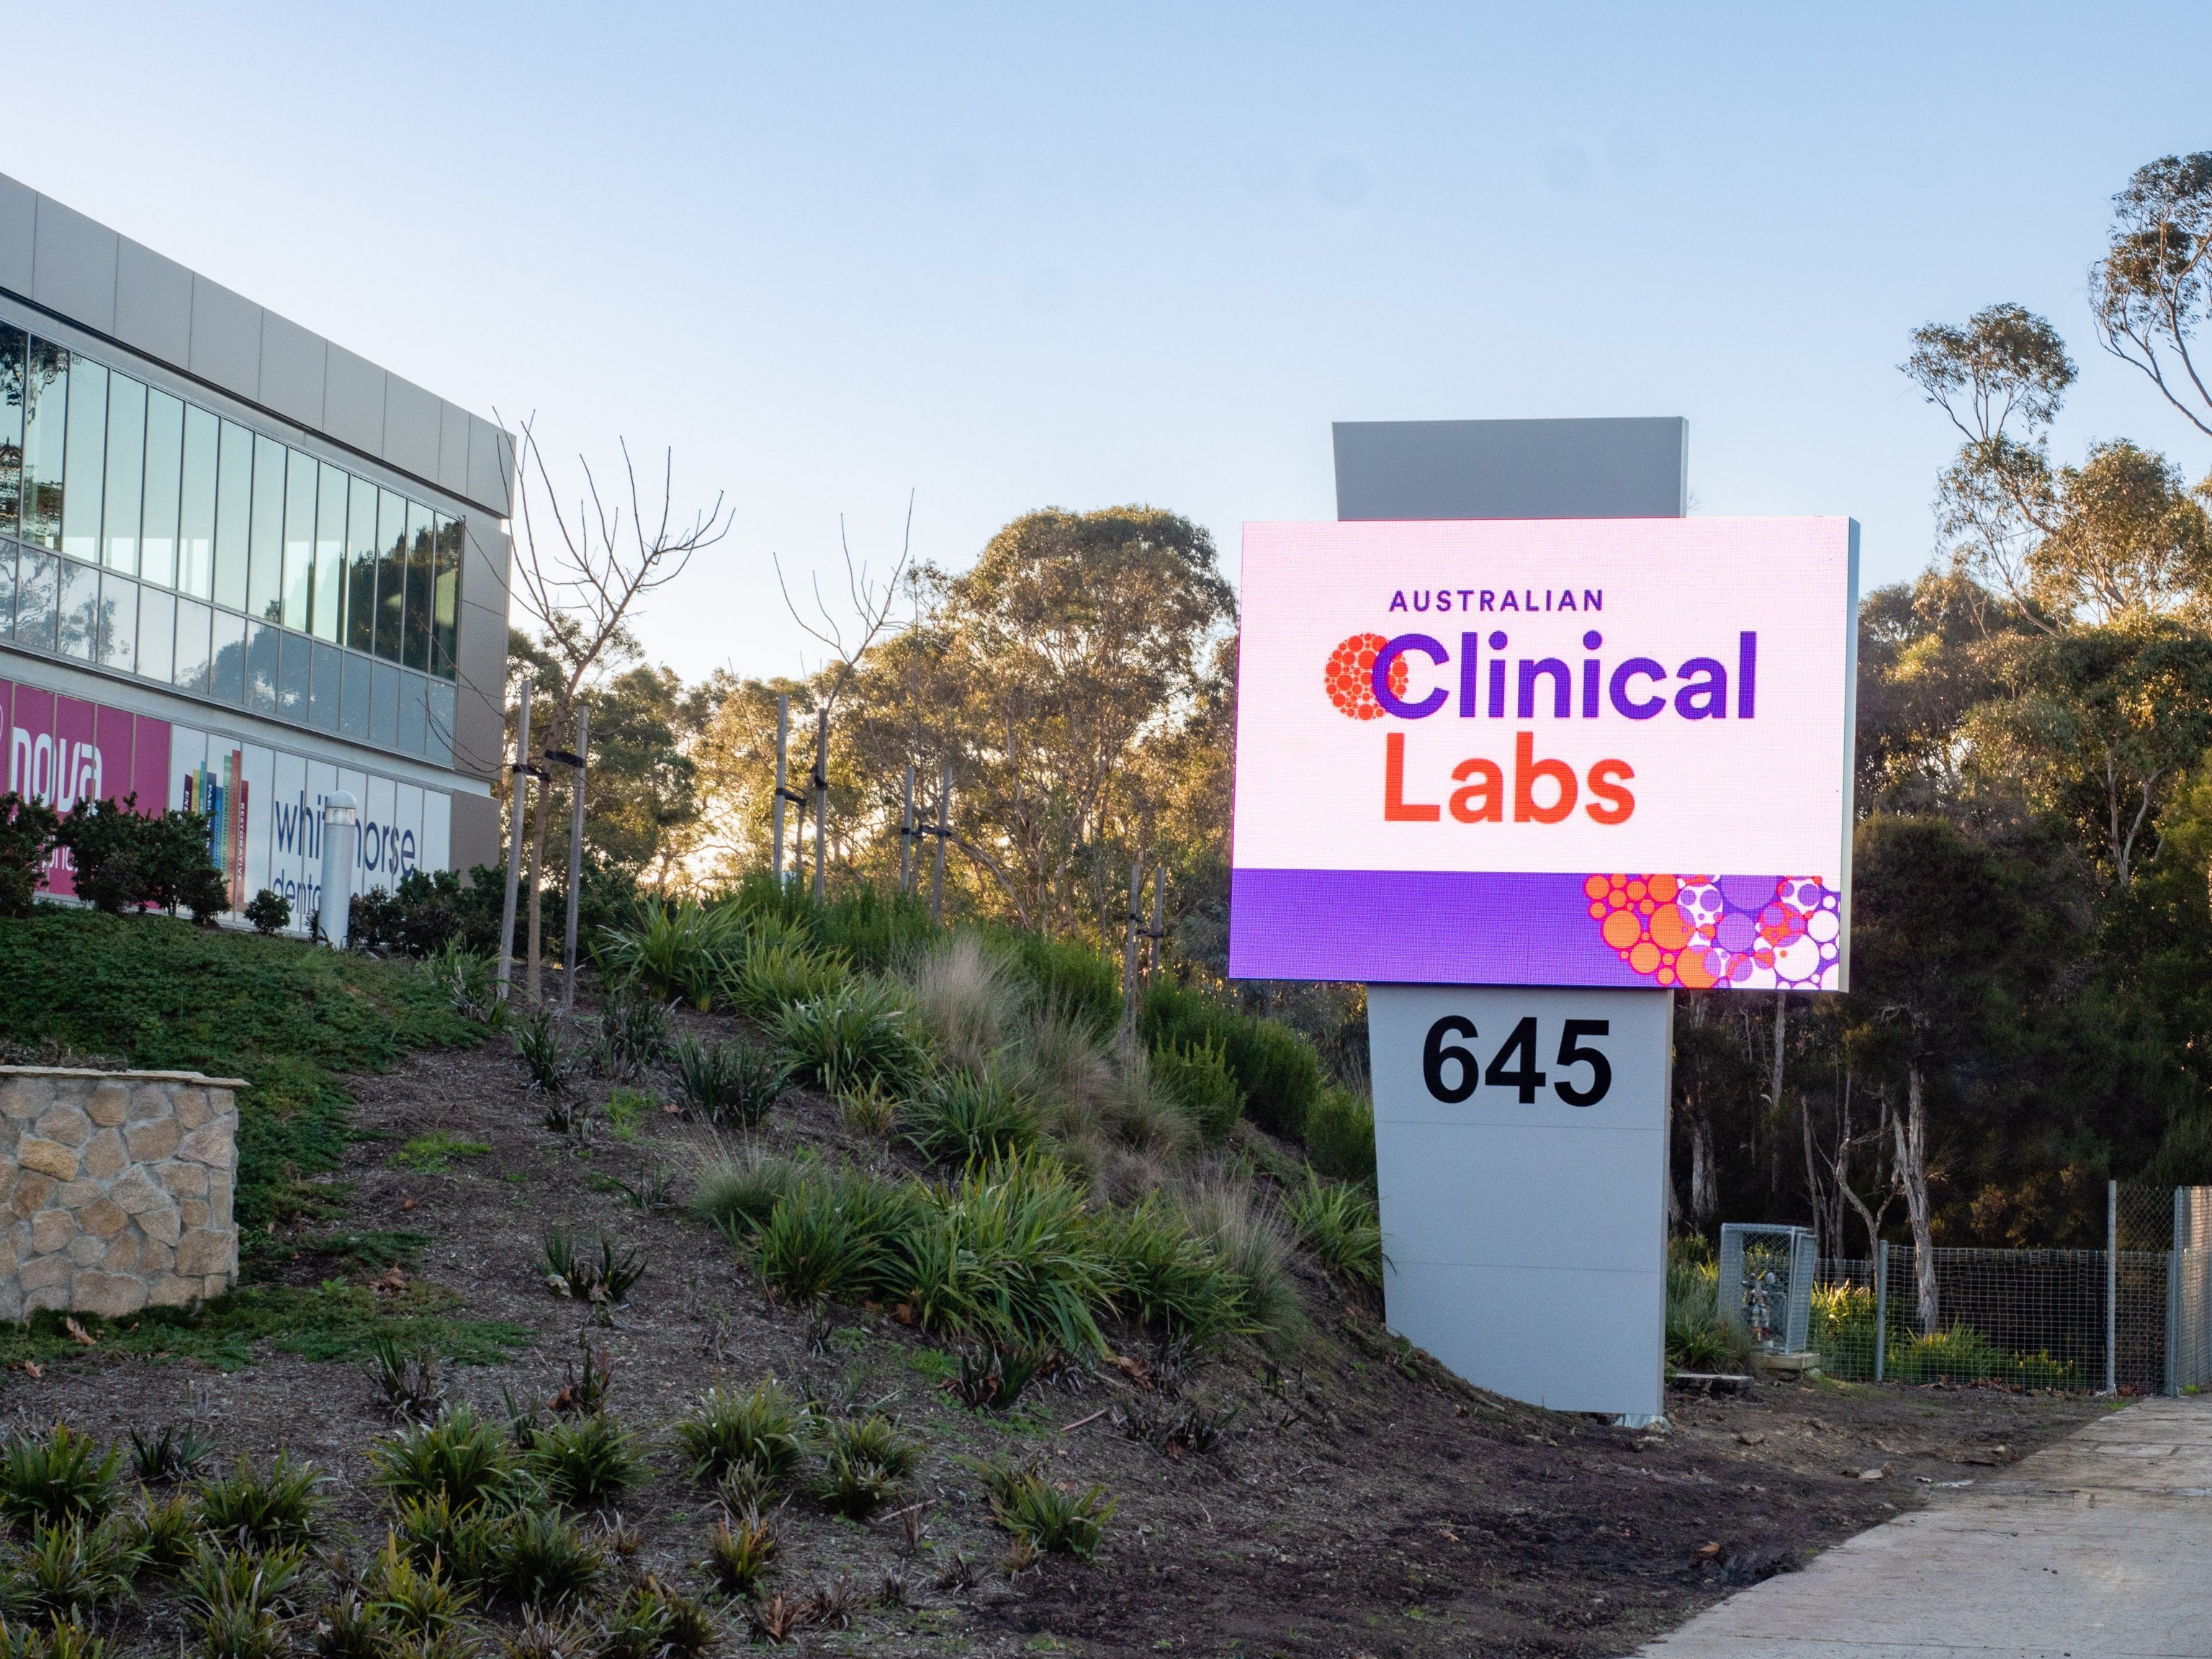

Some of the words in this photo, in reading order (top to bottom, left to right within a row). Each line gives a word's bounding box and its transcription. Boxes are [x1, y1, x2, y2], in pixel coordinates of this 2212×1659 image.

[1389, 589, 1604, 613] AUSTRALIAN
[1370, 630, 1757, 721] Clinical
[11, 727, 102, 816] nova
[1384, 732, 1636, 825] Labs
[1423, 1015, 1611, 1107] 645
